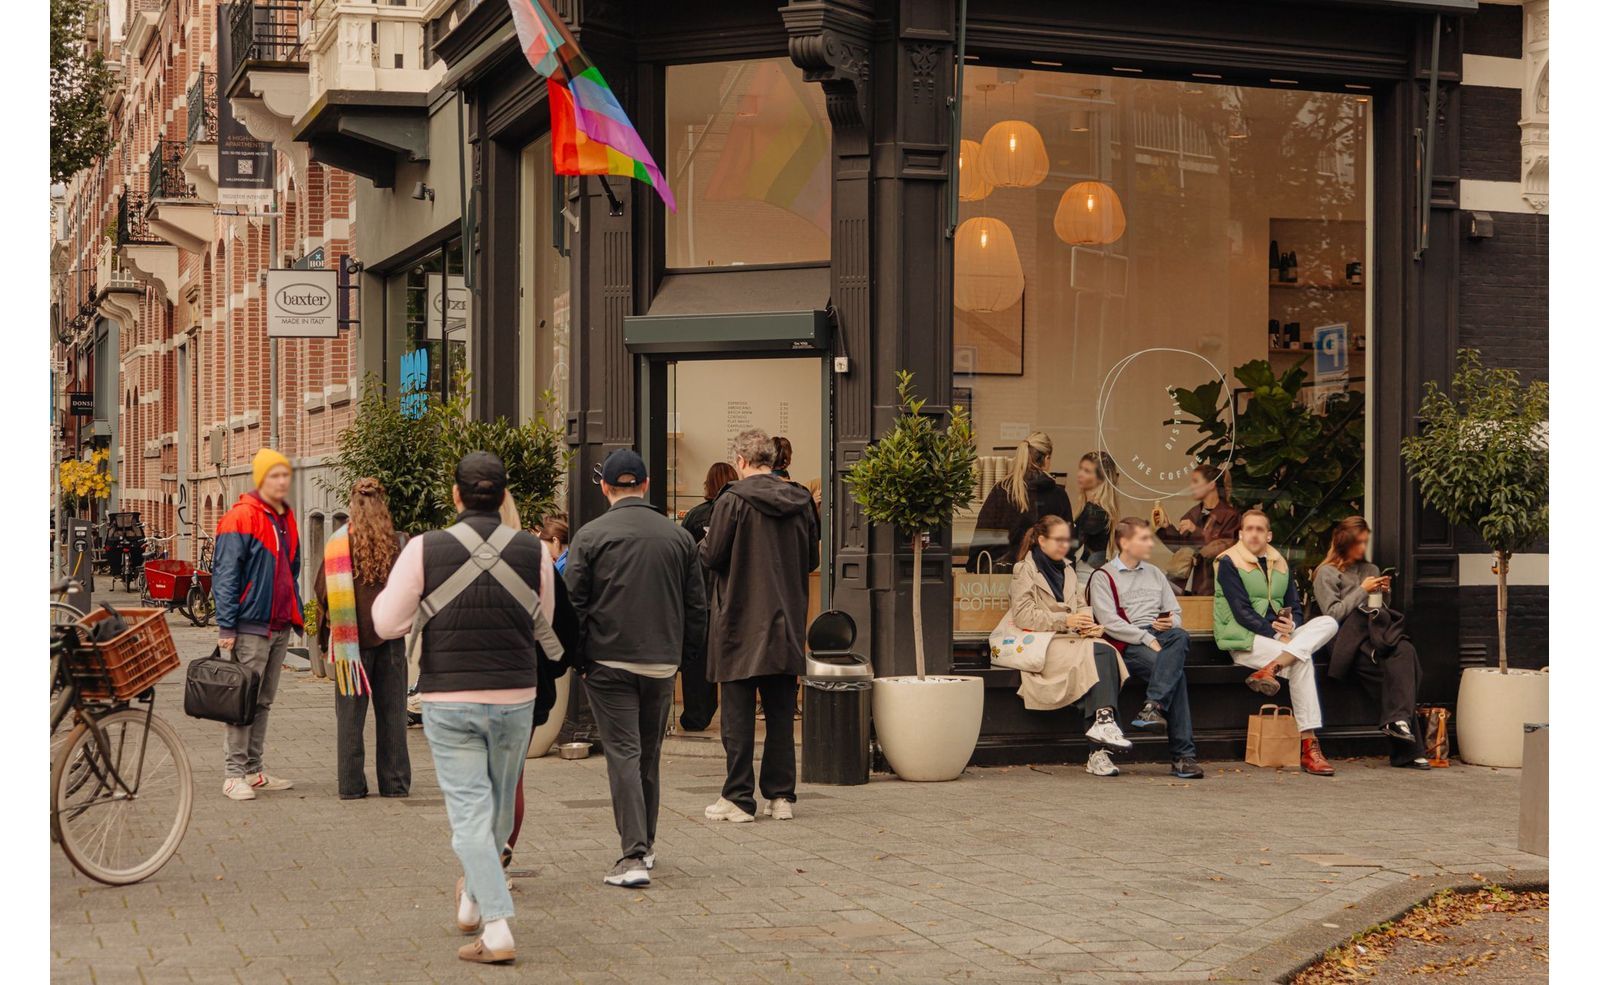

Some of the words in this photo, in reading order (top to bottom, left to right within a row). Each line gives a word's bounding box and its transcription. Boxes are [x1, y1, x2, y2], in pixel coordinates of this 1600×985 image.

[283, 291, 326, 306] baxter
[1164, 384, 1182, 451] DISTRICT
[1131, 454, 1153, 476] THE
[1159, 454, 1203, 480] COFFEE
